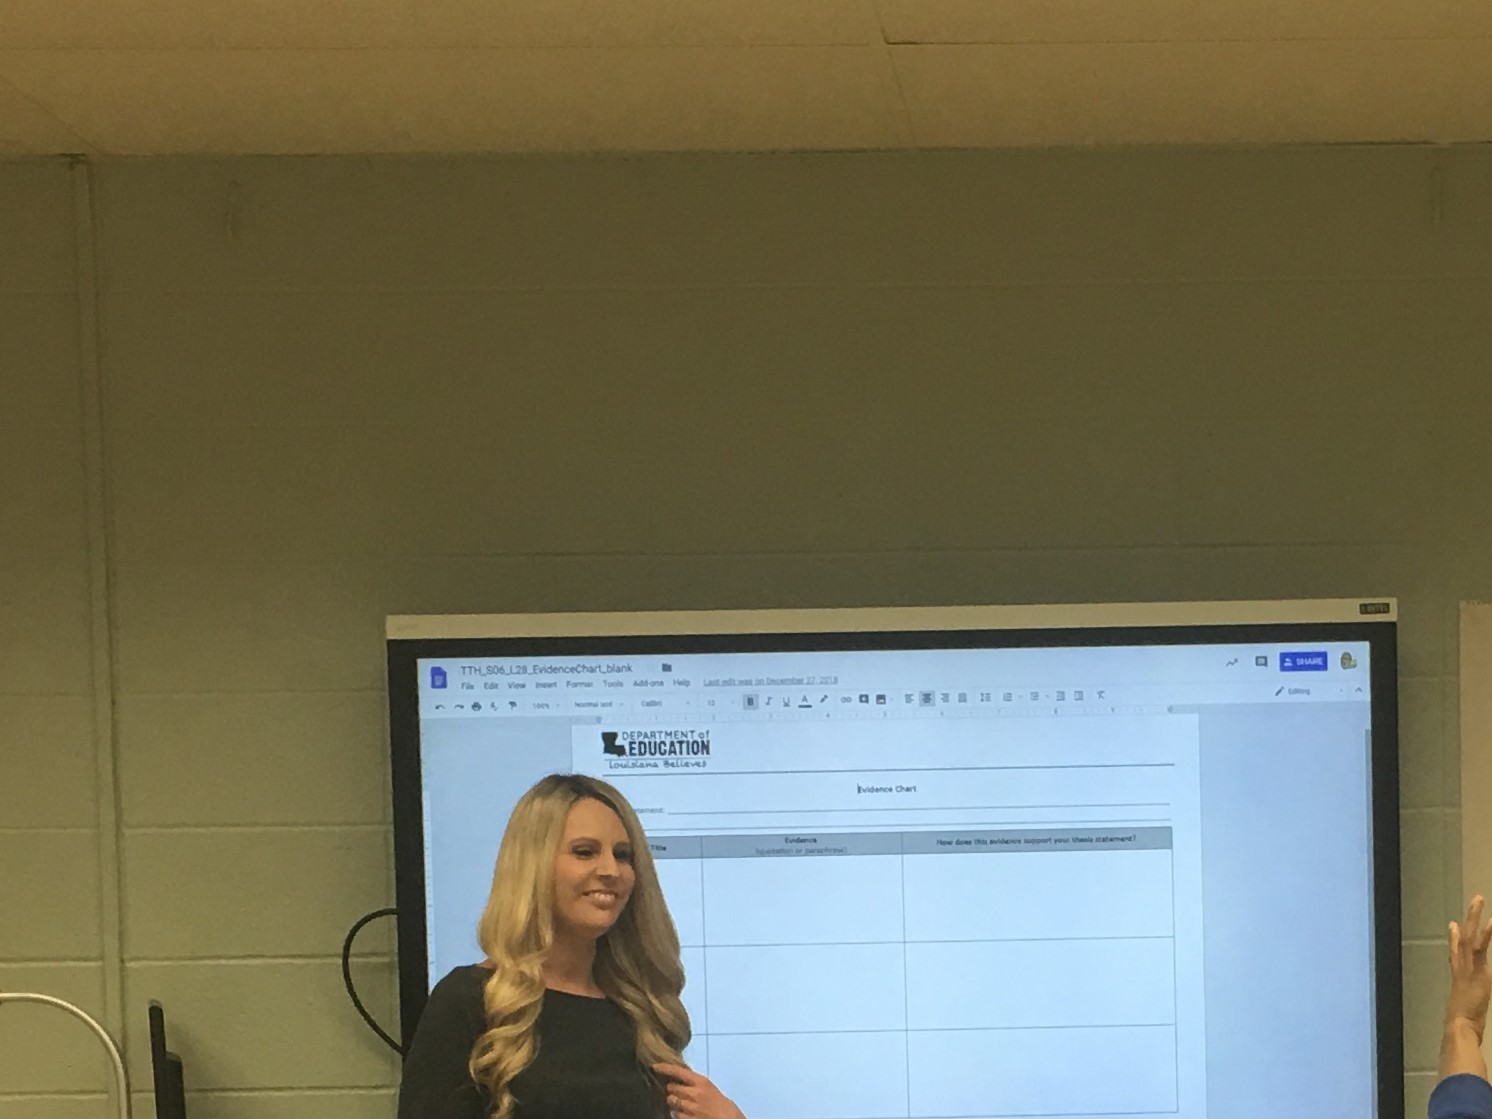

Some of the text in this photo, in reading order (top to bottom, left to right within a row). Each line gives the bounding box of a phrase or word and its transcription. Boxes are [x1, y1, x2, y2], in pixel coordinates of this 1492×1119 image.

[1296, 657, 1323, 666] SHARE
[461, 682, 474, 690] File
[484, 682, 499, 690] Edit
[508, 681, 526, 689] View
[566, 680, 593, 688] Format
[603, 680, 624, 688] Tools
[673, 678, 691, 688] Help
[622, 729, 710, 741] DEPARTMENT of
[628, 740, 711, 756] EDUCATION
[609, 759, 707, 769] Louisiana Believes
[858, 784, 917, 793] Evidence Chart
[784, 836, 817, 844] Evidence
